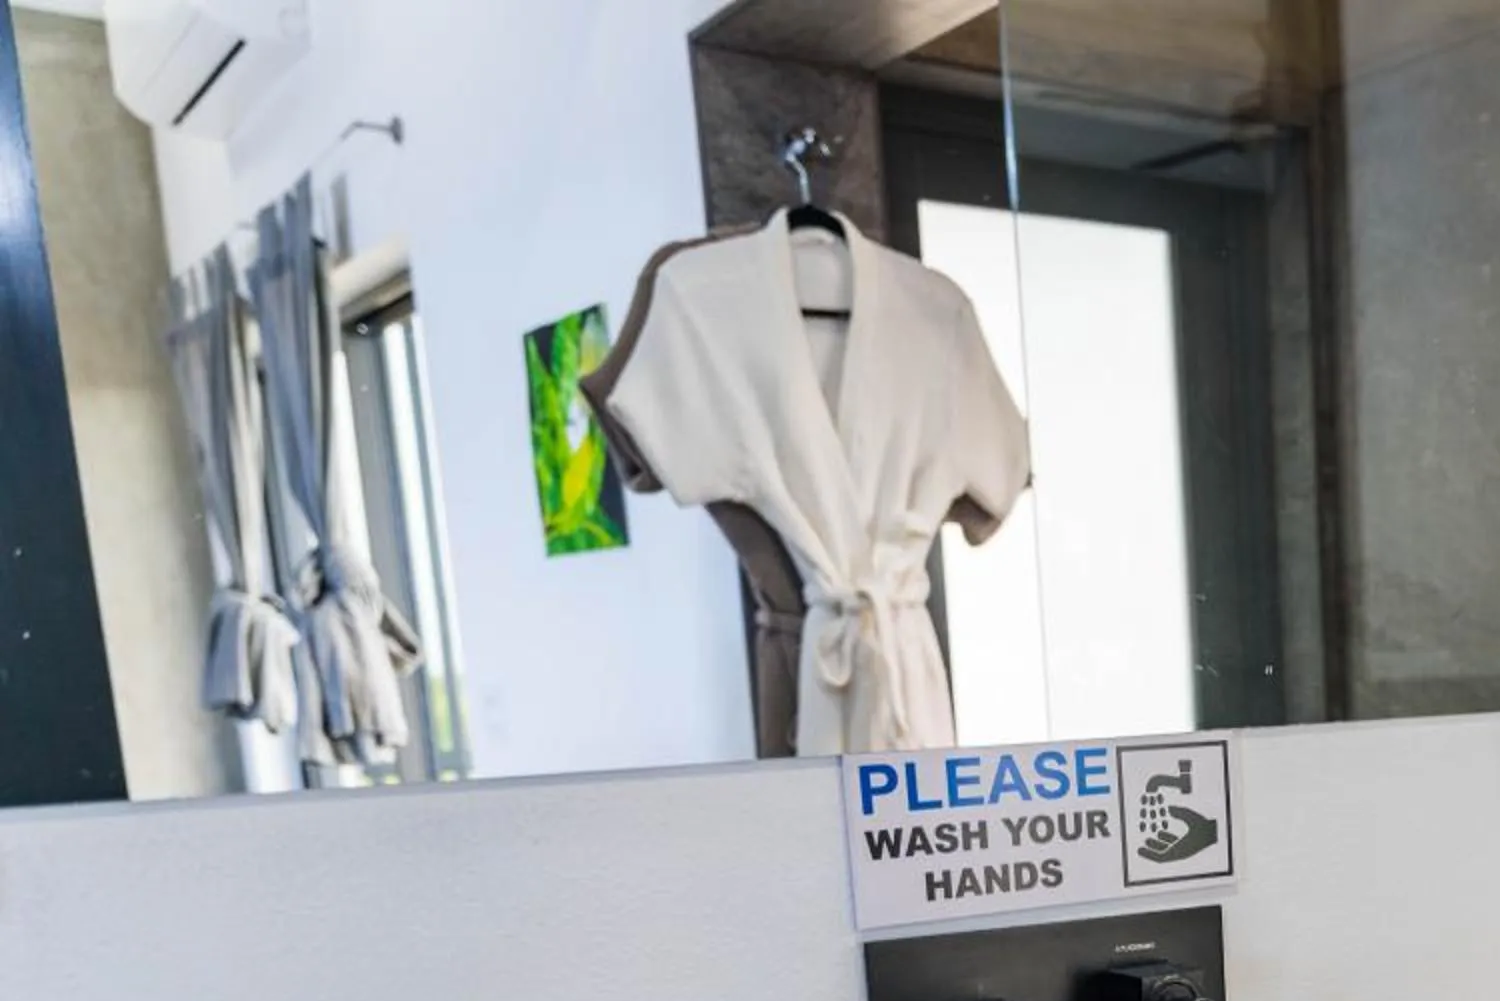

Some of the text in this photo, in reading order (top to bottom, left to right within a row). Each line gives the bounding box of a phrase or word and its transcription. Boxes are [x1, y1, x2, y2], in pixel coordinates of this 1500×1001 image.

[858, 748, 1111, 815] PLEASE
[865, 810, 1110, 860] WASH YOUR
[925, 859, 1063, 901] HANDS
